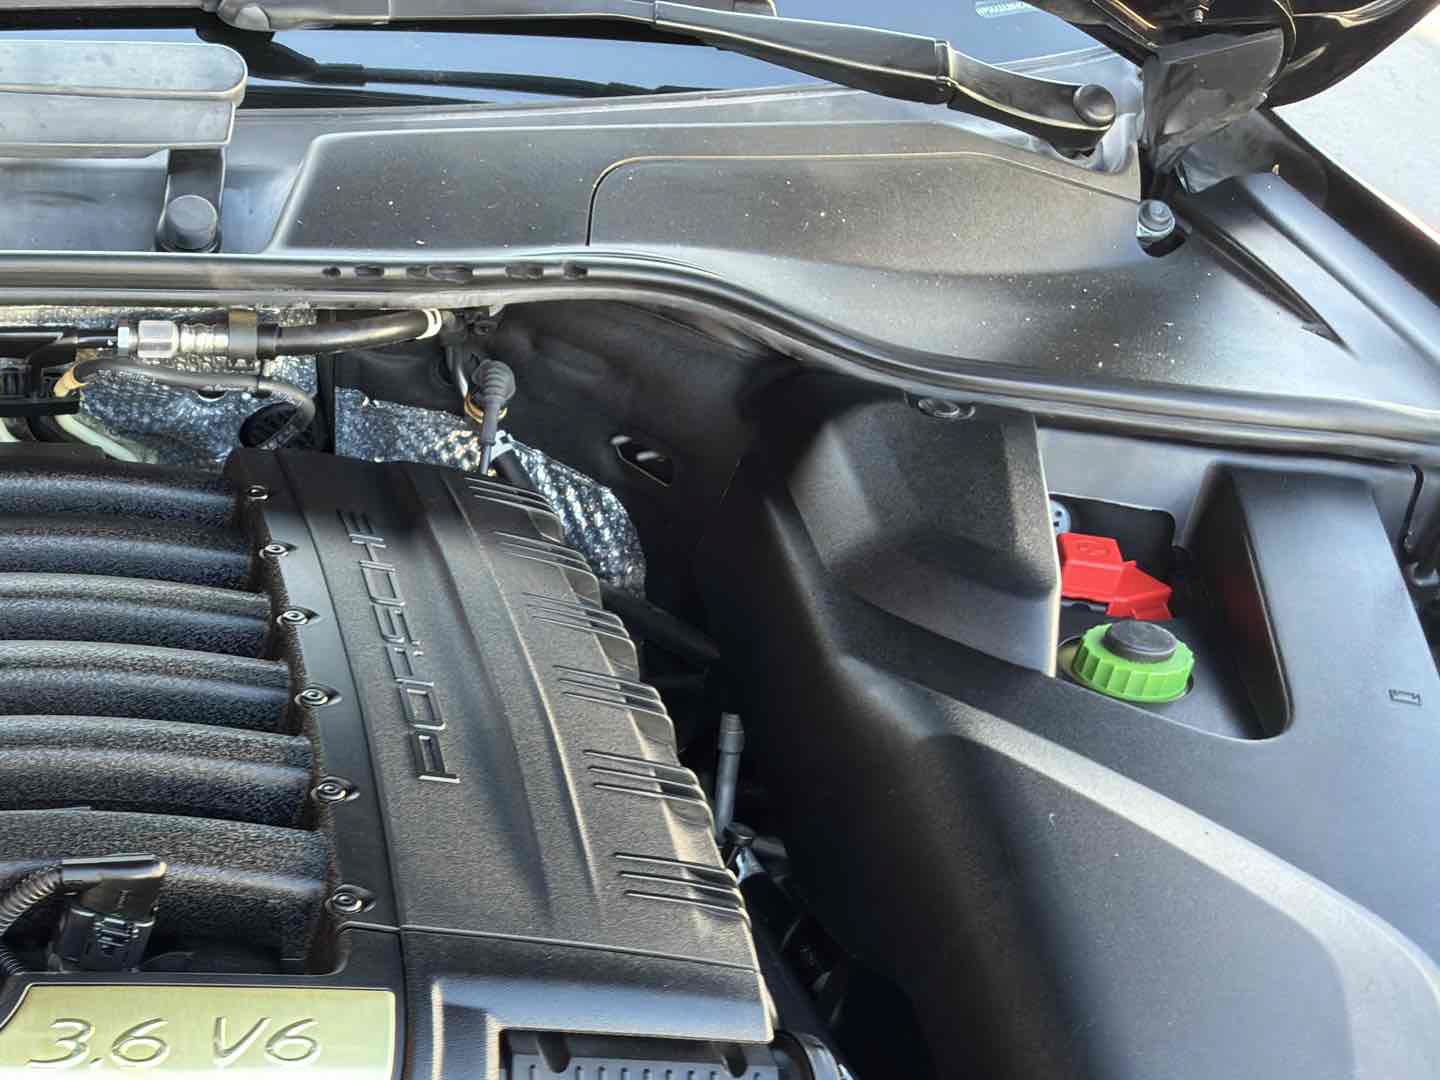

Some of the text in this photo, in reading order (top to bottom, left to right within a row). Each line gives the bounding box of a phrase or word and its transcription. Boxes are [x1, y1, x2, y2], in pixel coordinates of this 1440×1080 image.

[336, 509, 461, 784] PORSCHE
[24, 1016, 321, 1068] 3.6 V6
